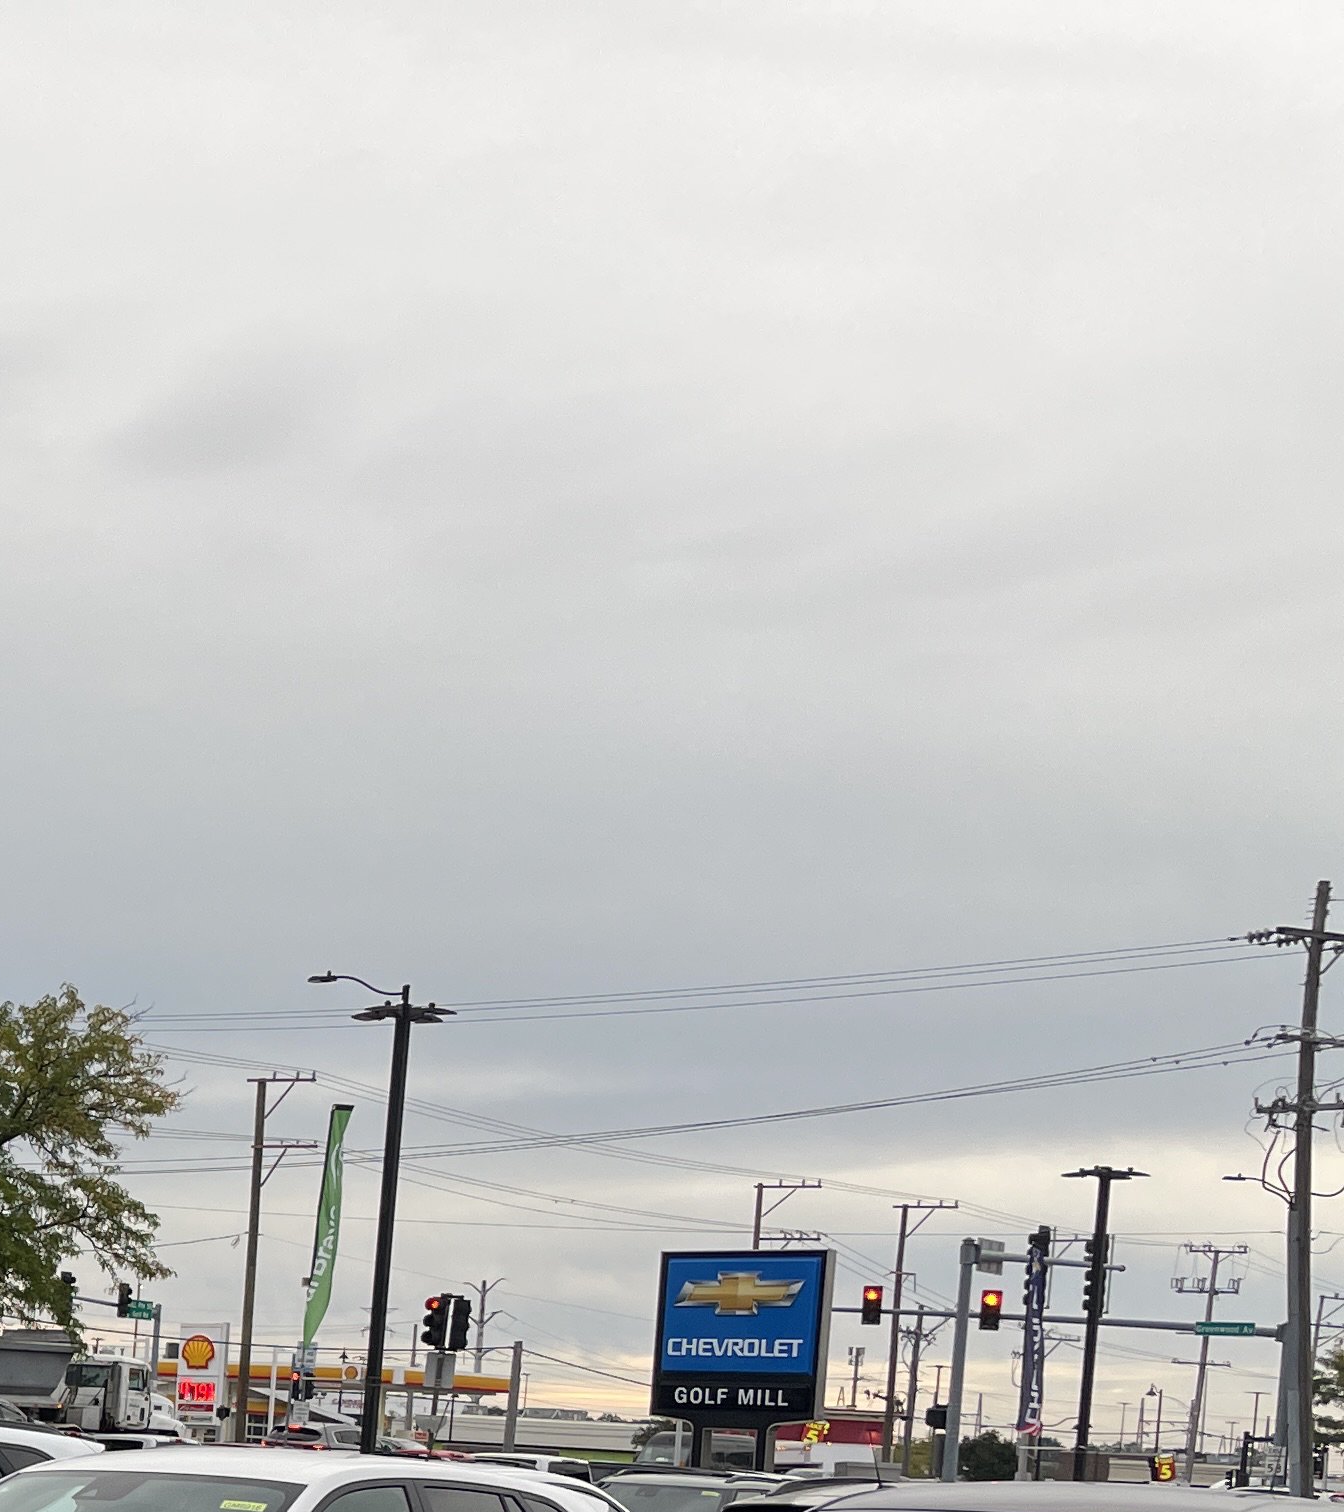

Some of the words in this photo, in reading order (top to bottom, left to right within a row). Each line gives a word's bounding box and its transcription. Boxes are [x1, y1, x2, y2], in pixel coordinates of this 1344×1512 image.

[667, 1338, 803, 1358] CHEVROLET
[674, 1387, 728, 1404] GOLF
[738, 1389, 789, 1406] MILL
[1159, 1465, 1172, 1480] 5
